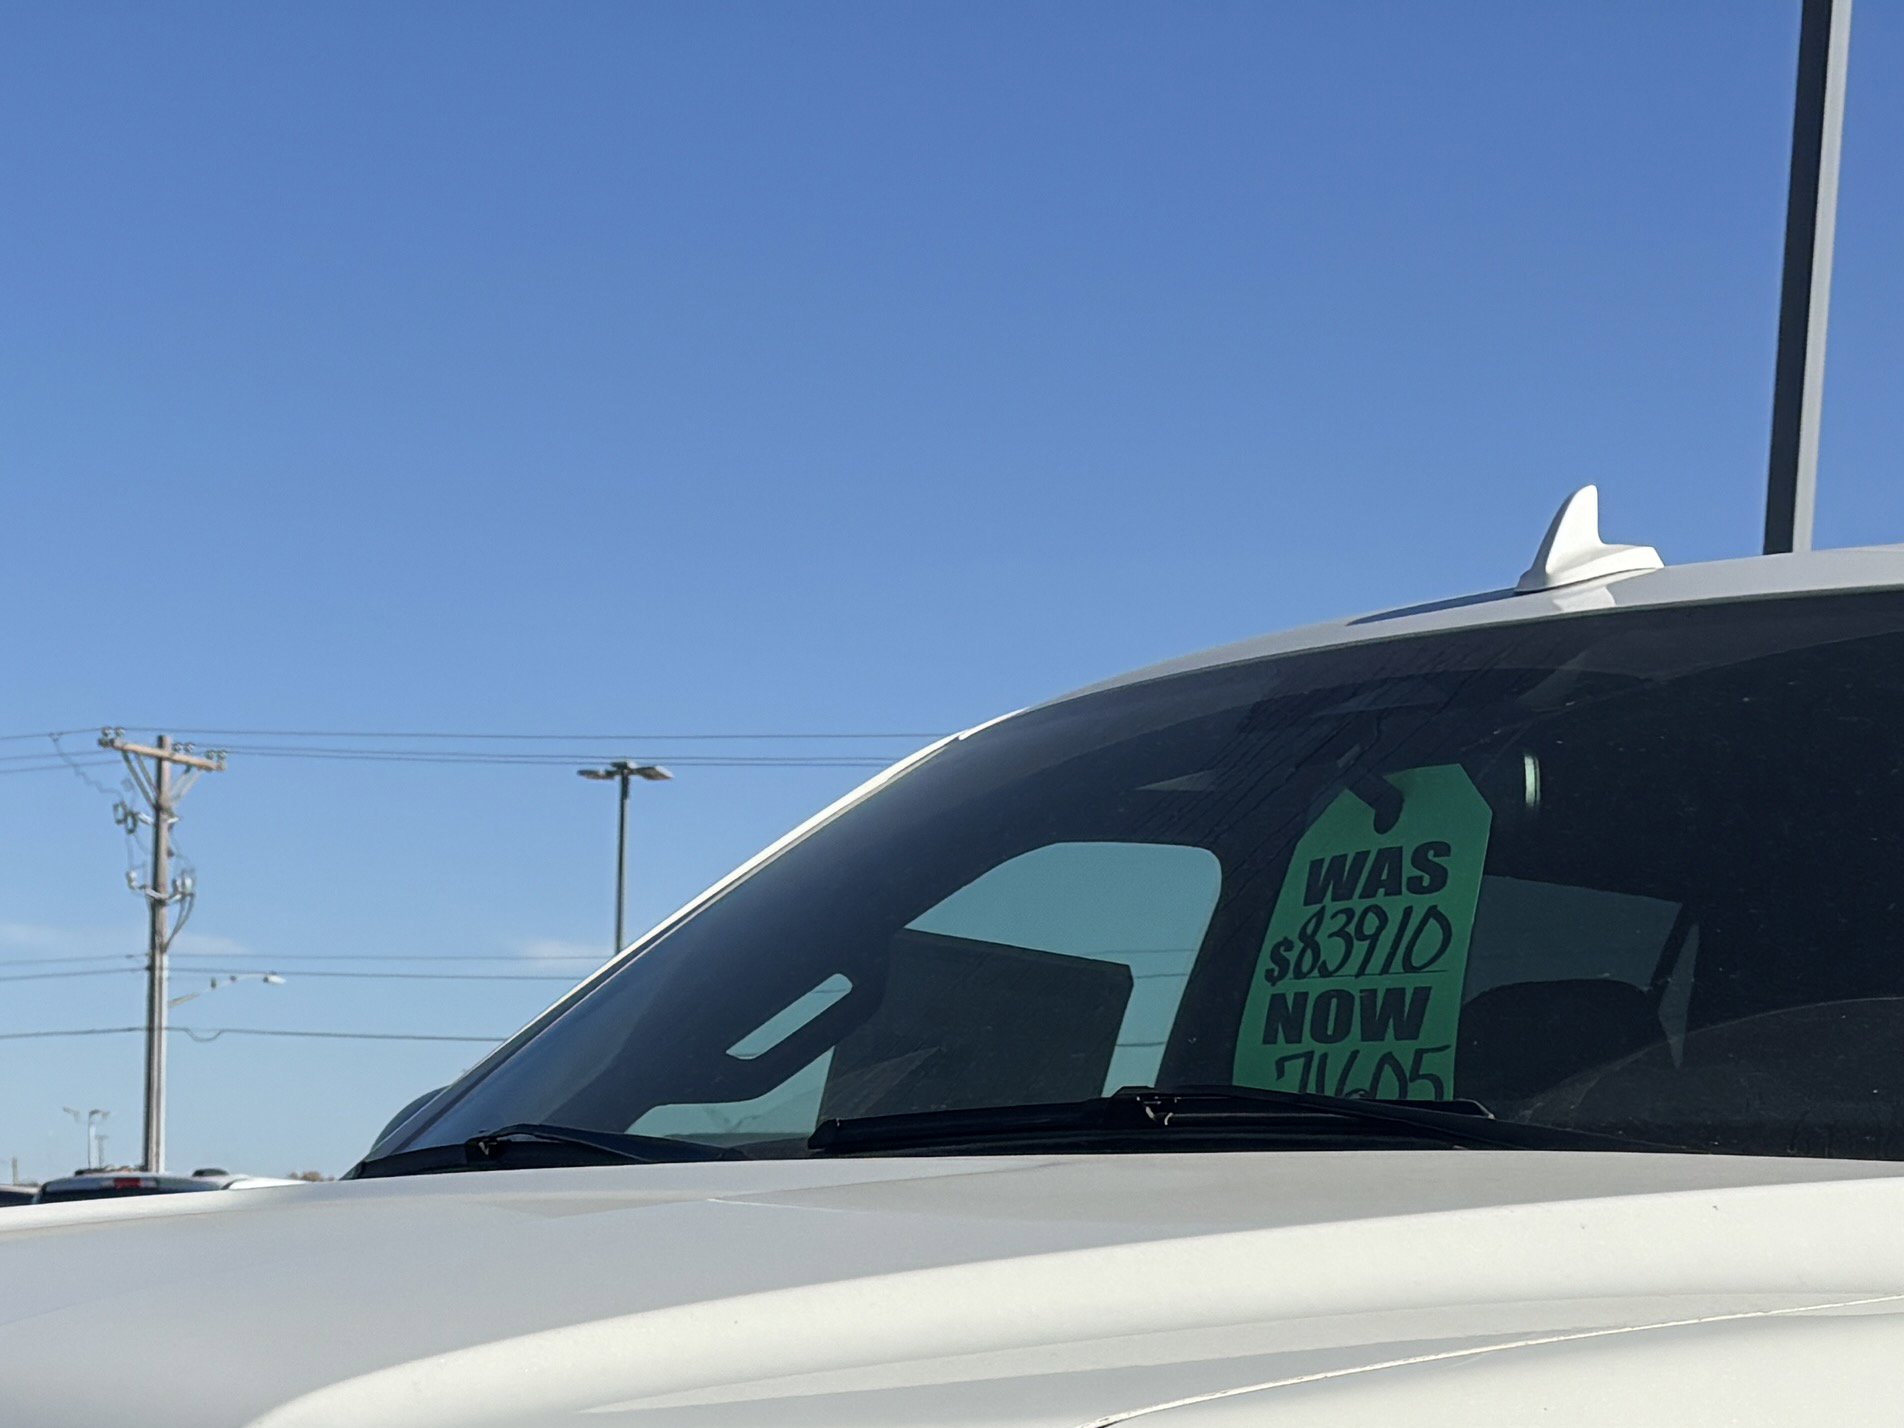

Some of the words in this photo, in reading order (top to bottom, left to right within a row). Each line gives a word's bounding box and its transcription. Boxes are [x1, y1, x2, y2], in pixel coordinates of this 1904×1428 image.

[1303, 841, 1452, 907] WAS
[1264, 904, 1453, 986] $83910
[1262, 986, 1433, 1046] NOW
